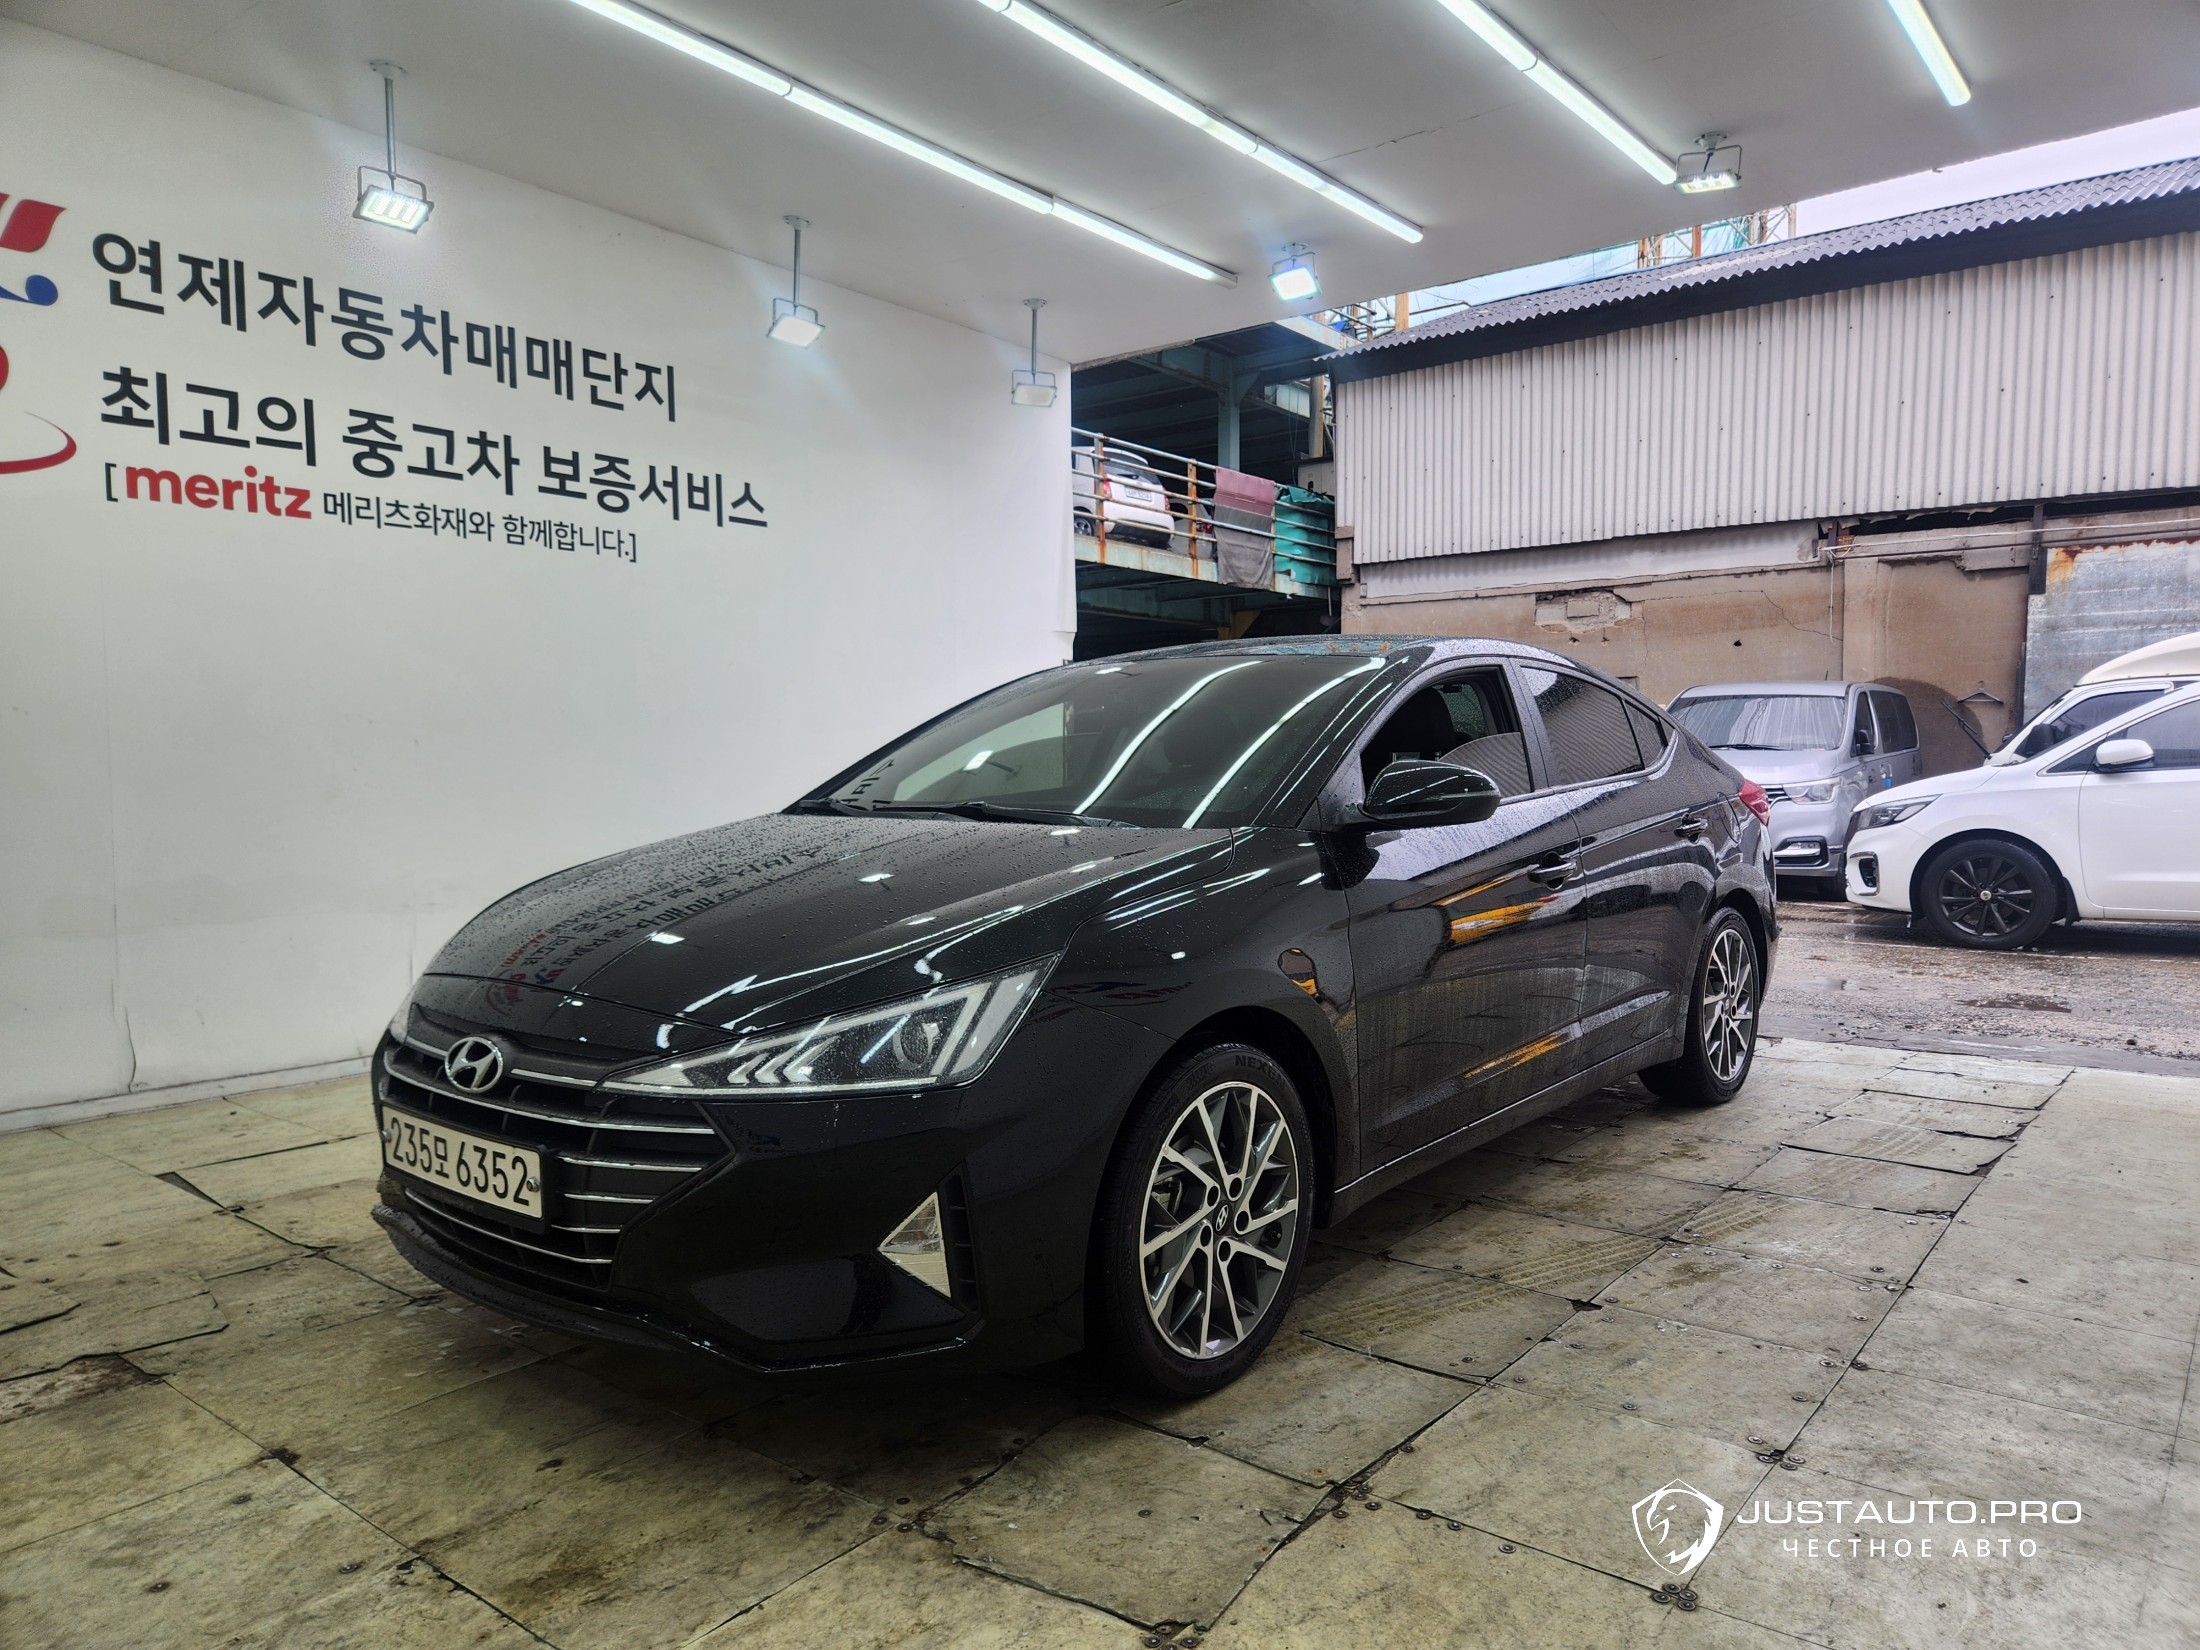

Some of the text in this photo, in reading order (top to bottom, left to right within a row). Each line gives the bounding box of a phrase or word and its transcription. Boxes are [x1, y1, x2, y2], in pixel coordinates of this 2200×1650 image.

[92, 232, 678, 422] 연제자동차매매단지
[101, 366, 768, 529] 최고의 중고차 보증서비스
[323, 491, 495, 542] 메리츠화재와
[391, 1116, 530, 1207] 235모 6352
